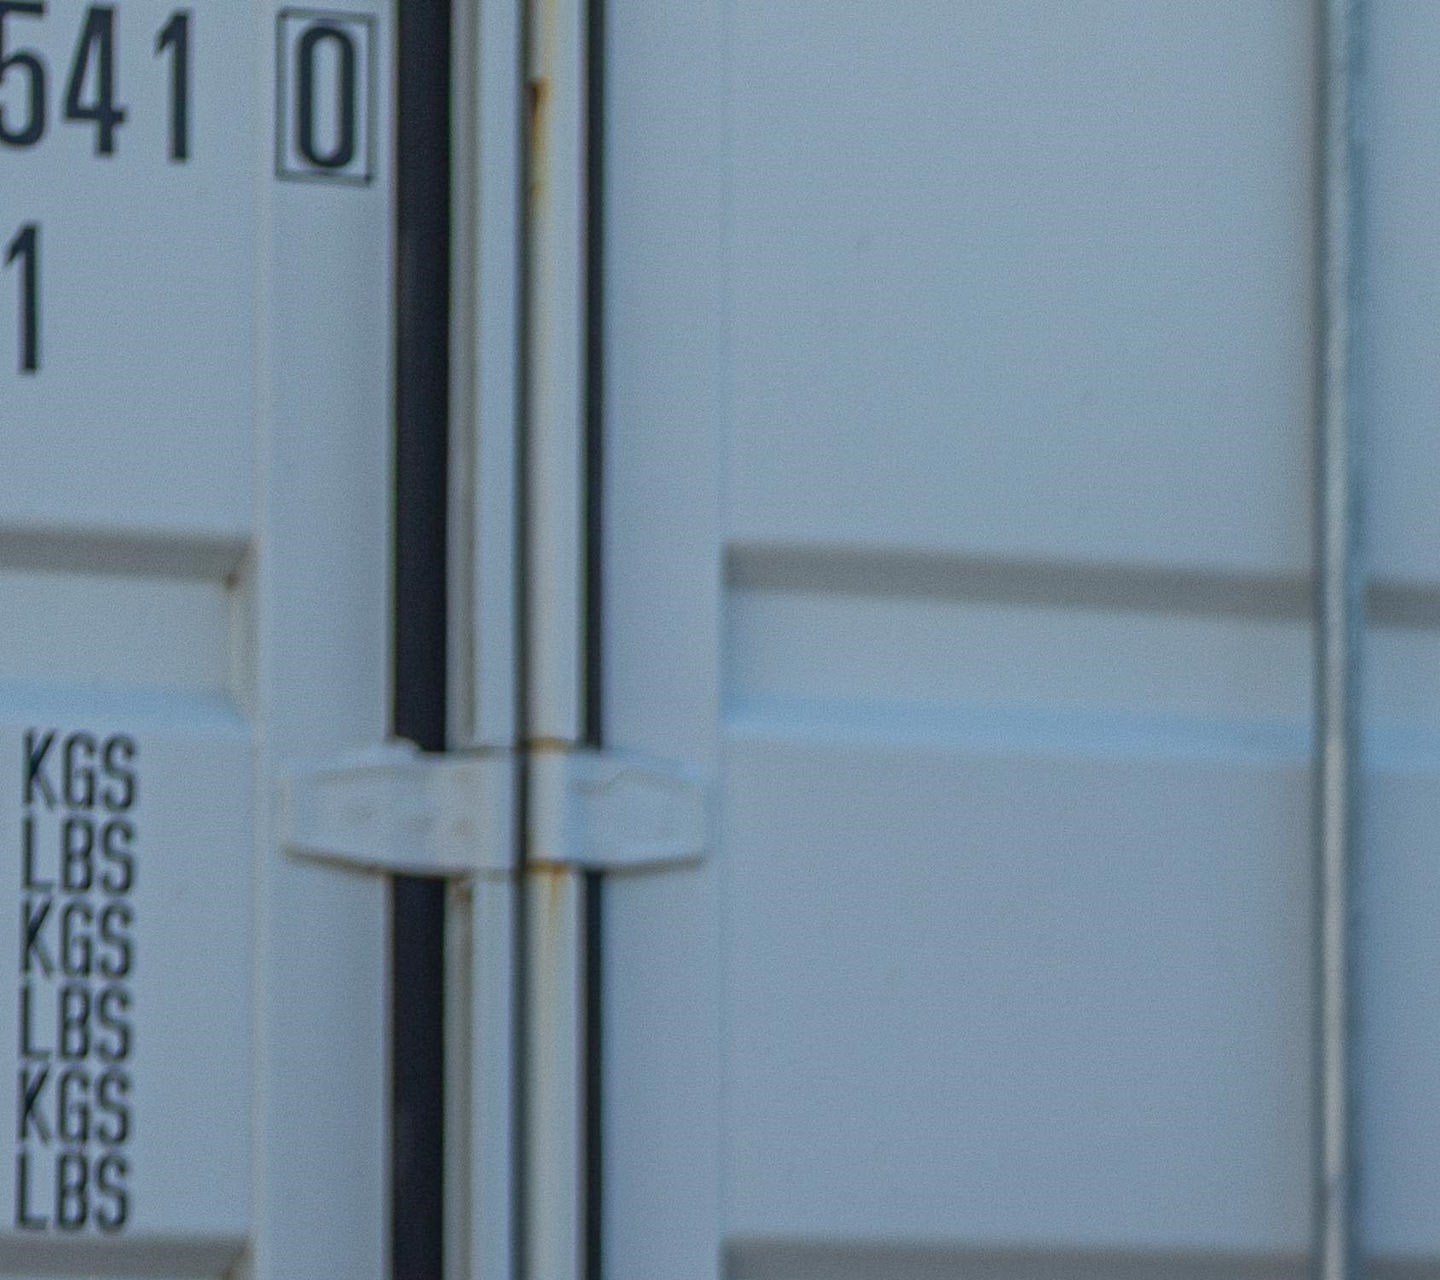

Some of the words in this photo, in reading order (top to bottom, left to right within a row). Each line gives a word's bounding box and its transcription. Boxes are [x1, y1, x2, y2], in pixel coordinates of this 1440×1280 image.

[22, 729, 137, 811] KGS
[21, 813, 136, 896] LBS
[20, 897, 135, 980] KGS
[18, 981, 133, 1063] LBS
[17, 1064, 132, 1146] KGS
[14, 1148, 130, 1232] LBS
